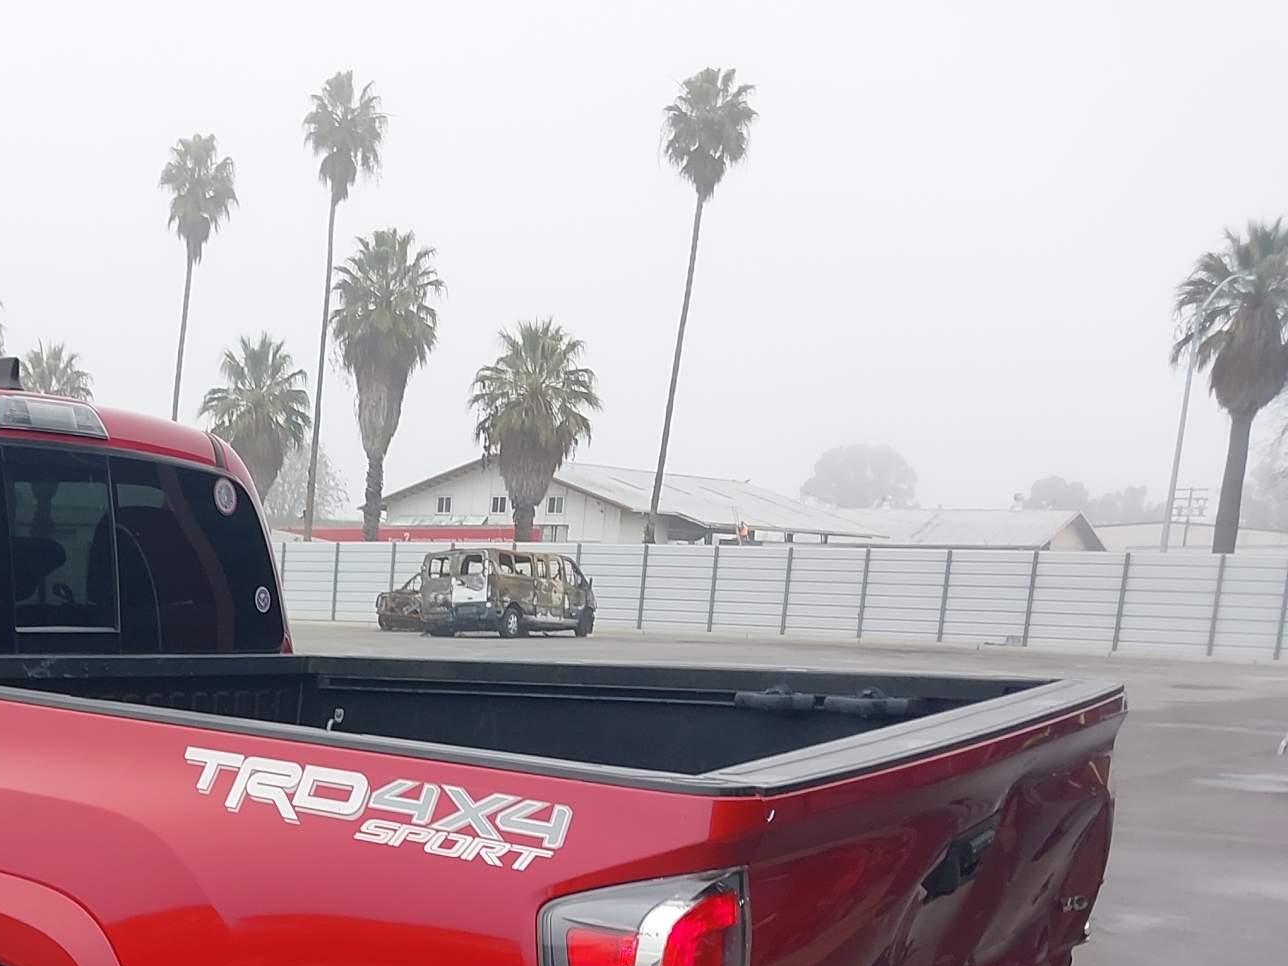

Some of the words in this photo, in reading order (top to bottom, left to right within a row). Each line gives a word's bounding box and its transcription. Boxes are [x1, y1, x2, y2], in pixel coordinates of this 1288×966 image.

[184, 746, 371, 825] TRD
[368, 778, 573, 850] 4X4
[353, 819, 554, 872] SPORT
